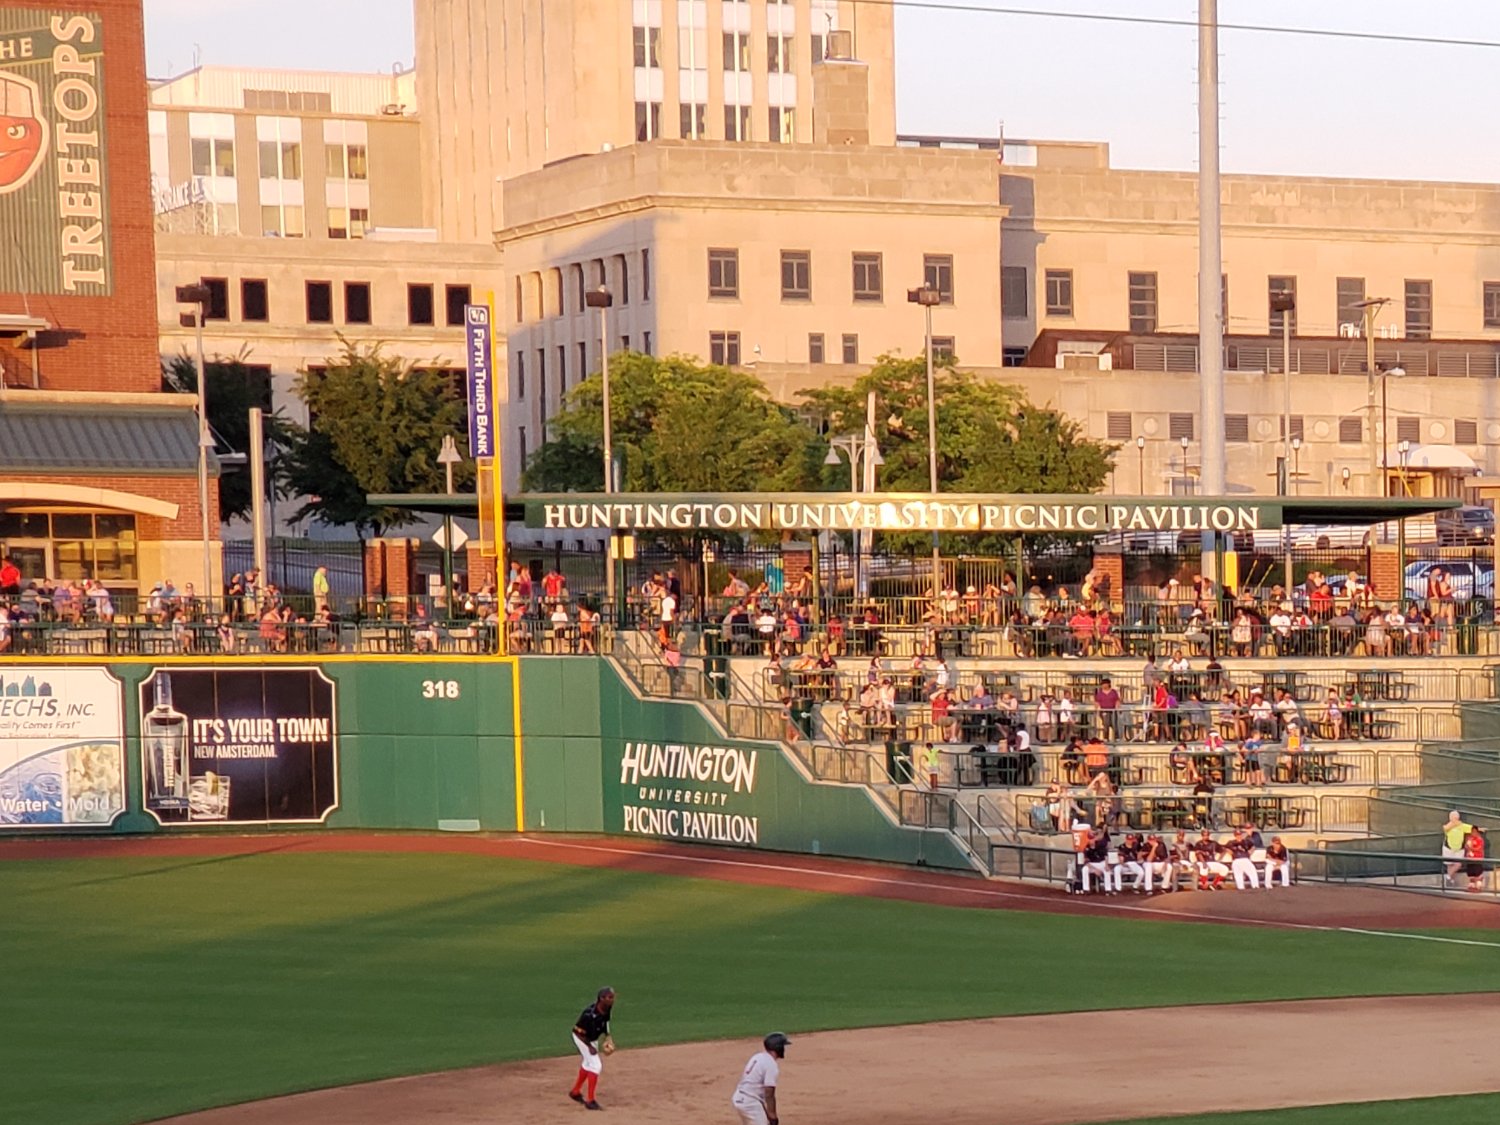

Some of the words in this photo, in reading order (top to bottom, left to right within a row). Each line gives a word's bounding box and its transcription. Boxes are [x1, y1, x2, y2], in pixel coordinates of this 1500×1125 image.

[0, 38, 33, 60] HE
[51, 16, 105, 291] TREETOPS
[475, 369, 487, 413] THIRD
[476, 415, 488, 454] BANK
[544, 503, 762, 528] HUNTINGTON
[777, 501, 968, 528] UNIVERSITY
[981, 505, 1098, 529] PICNIC
[1111, 505, 1260, 530] PAVILION
[422, 680, 459, 698] 318
[0, 699, 61, 717] ECHS,
[66, 703, 96, 716] INC.
[193, 718, 225, 743] IT'S
[228, 718, 274, 743] YOUR
[276, 718, 329, 743] TOWN
[194, 745, 215, 759] NEW
[620, 742, 757, 793] HUNTINGTON
[2, 798, 50, 812] Water
[69, 797, 110, 811] Mold
[639, 786, 728, 806] UNIVERSITY
[623, 805, 679, 837] PICNIC
[682, 811, 758, 844] PAVILION
